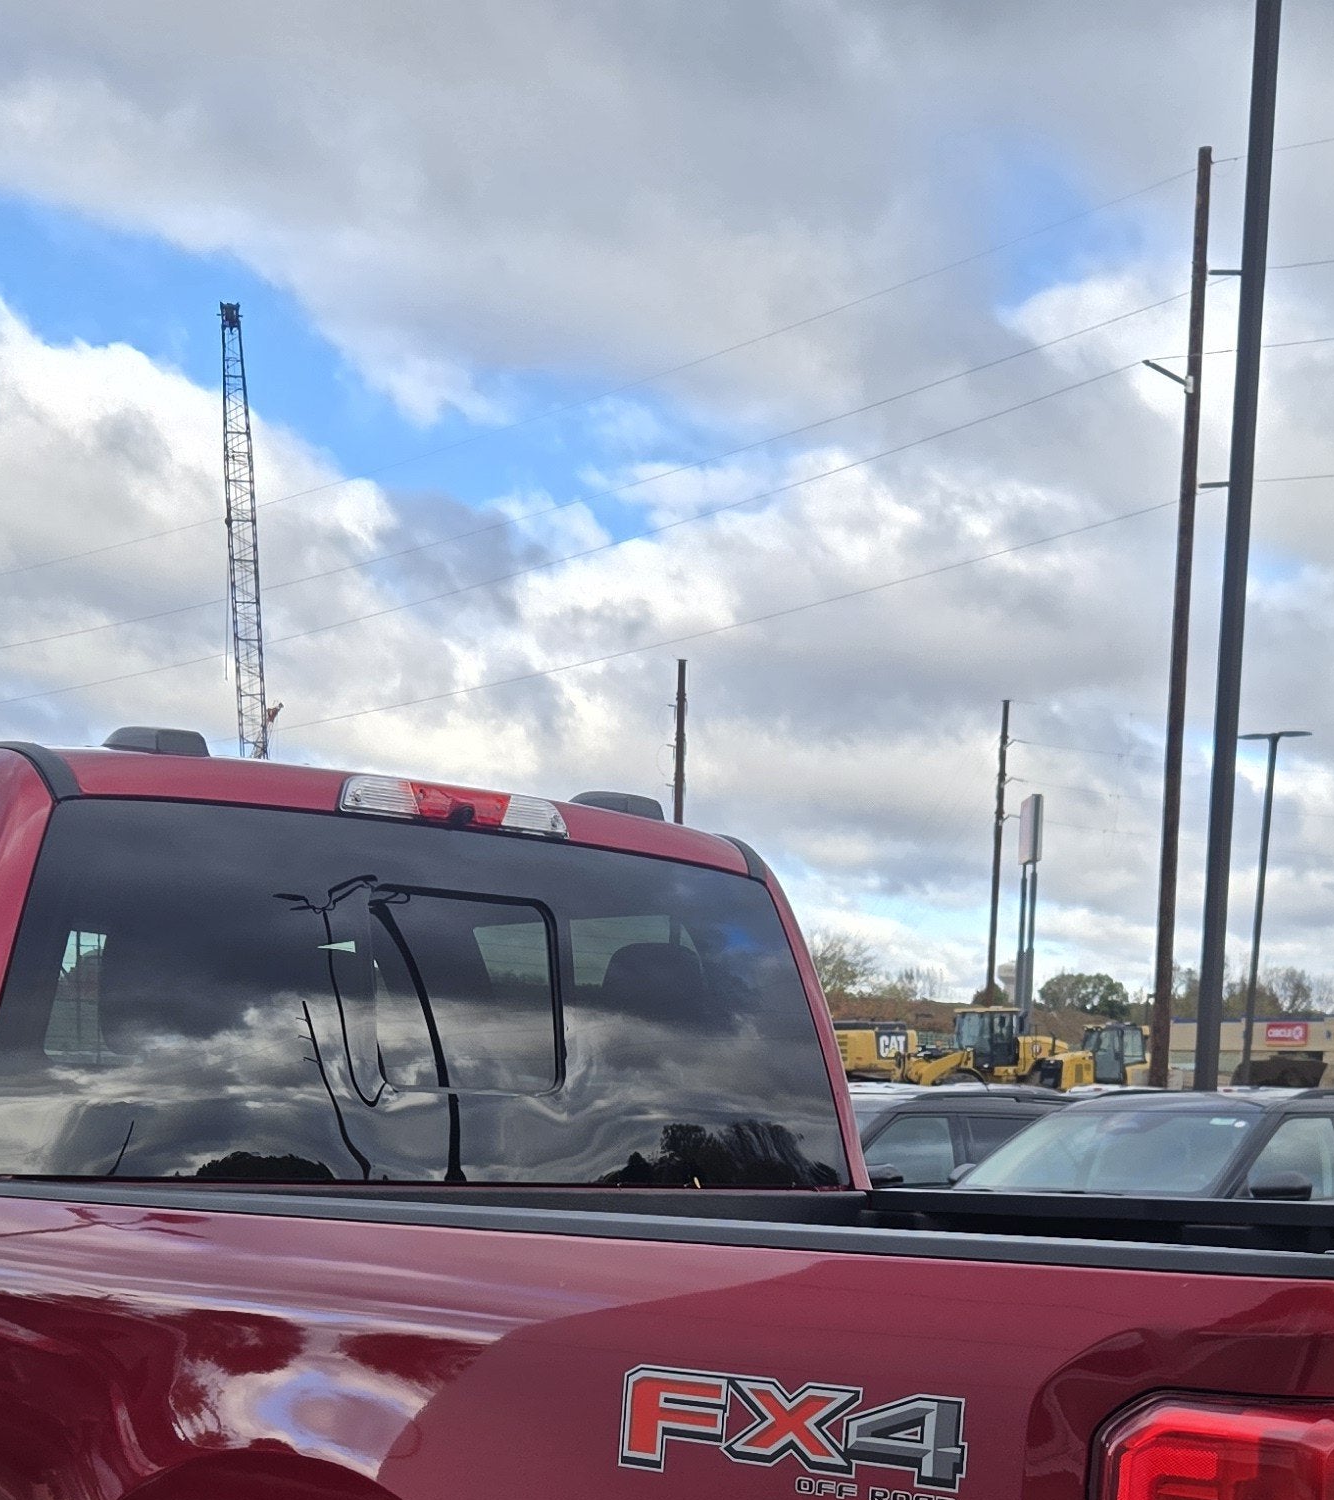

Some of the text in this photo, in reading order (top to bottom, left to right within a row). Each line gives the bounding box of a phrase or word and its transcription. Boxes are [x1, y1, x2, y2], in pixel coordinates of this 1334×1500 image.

[879, 1034, 906, 1058] CAT
[618, 1363, 968, 1493] FX4
[795, 1476, 858, 1500] OFF
